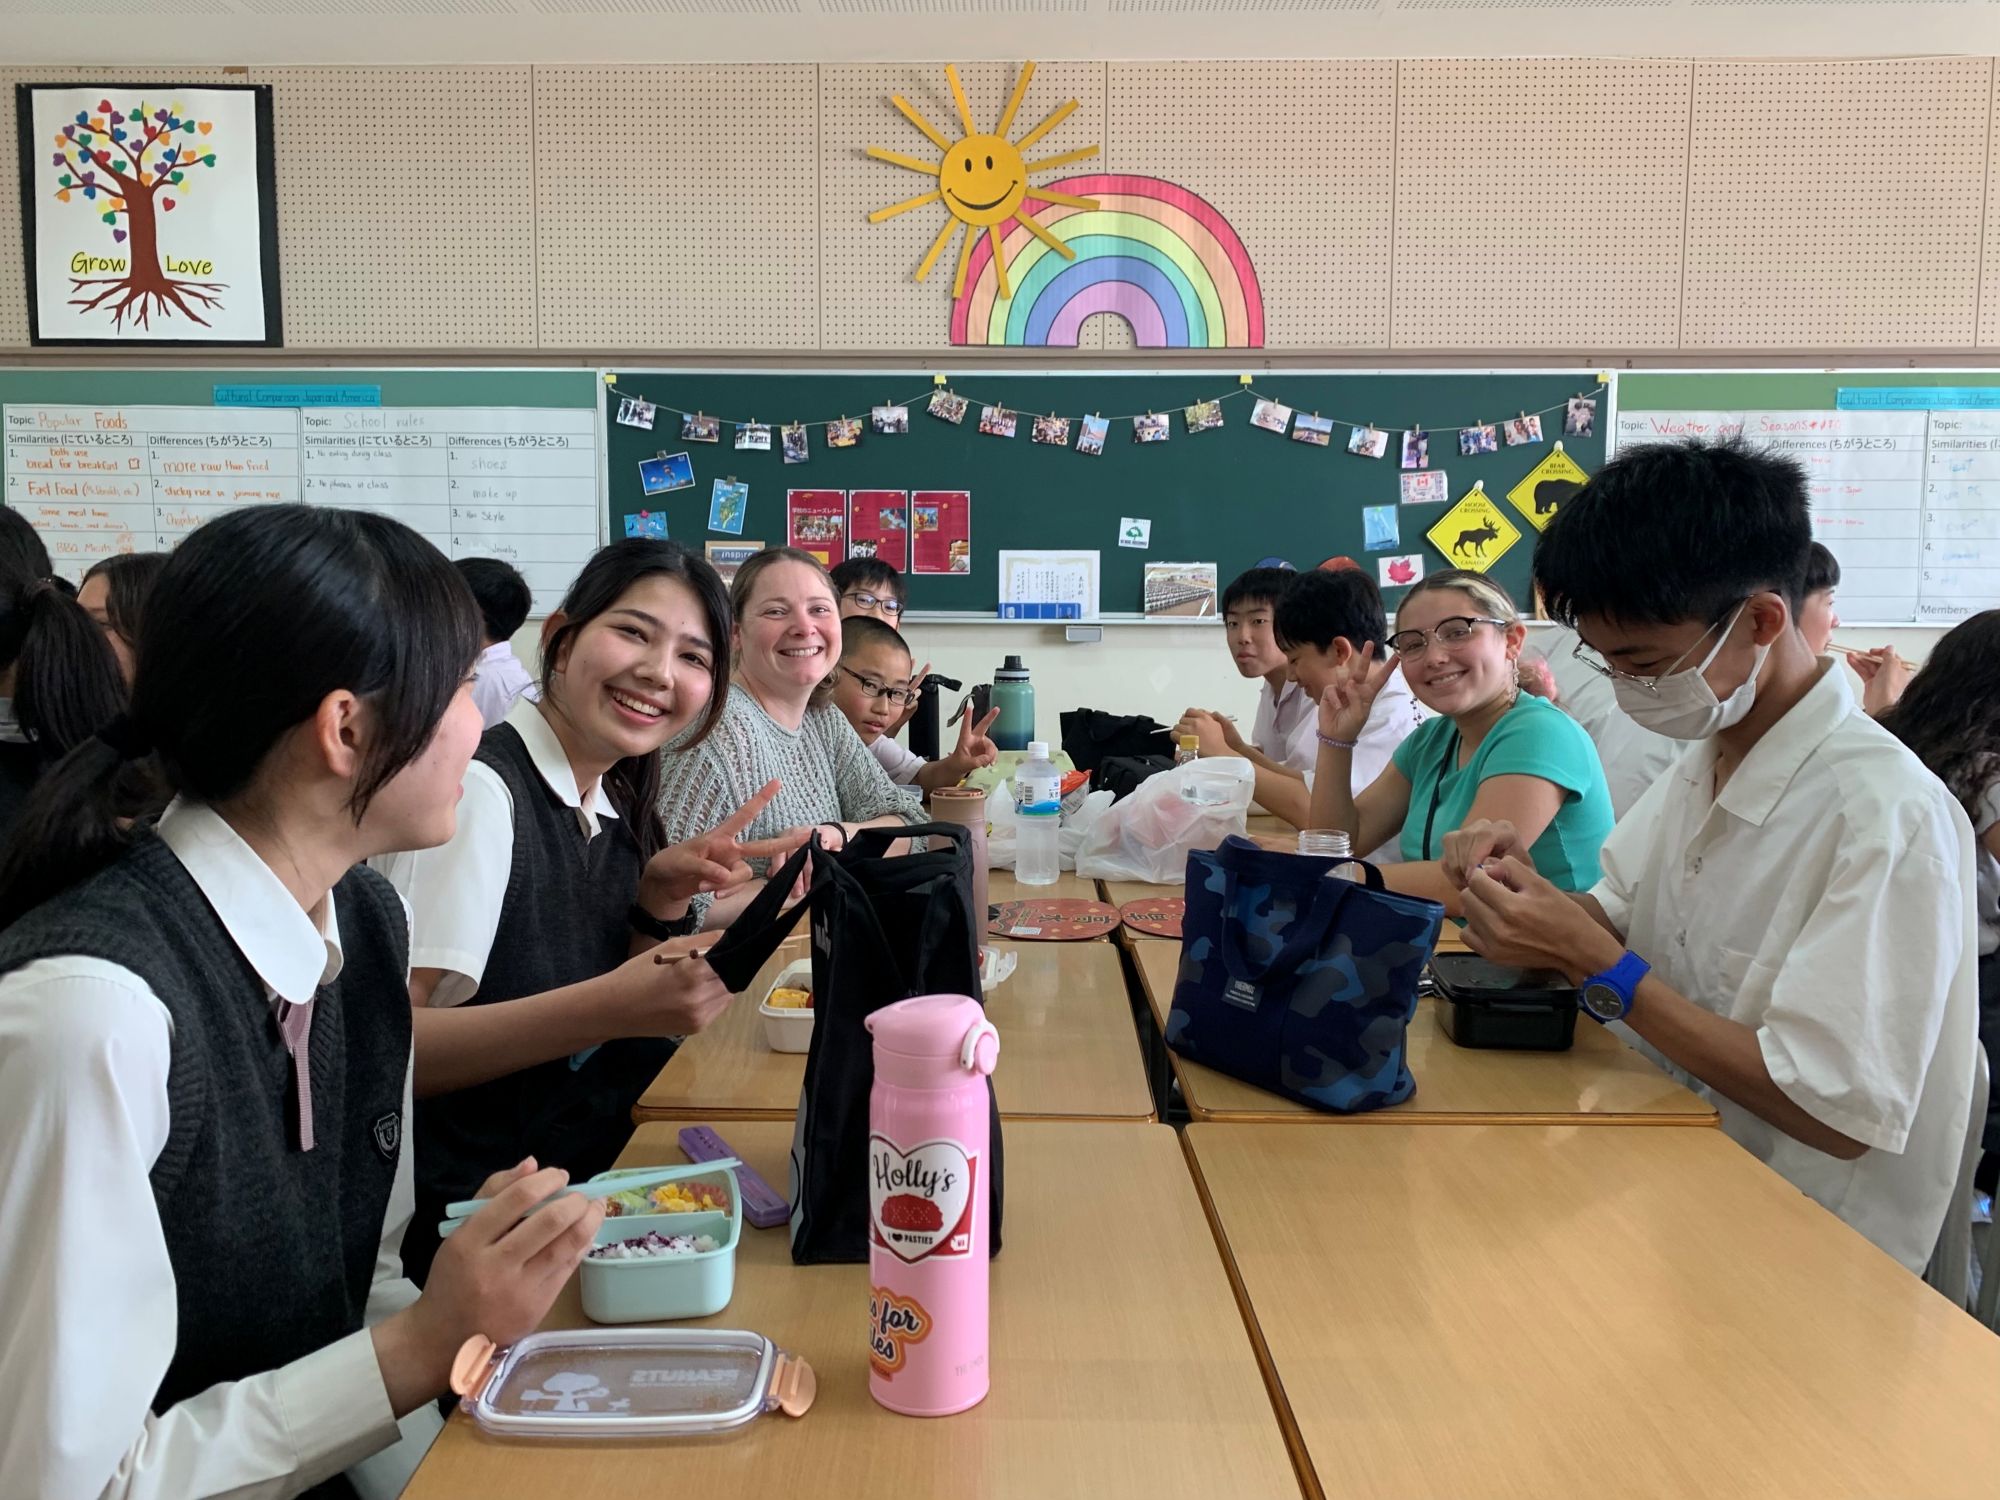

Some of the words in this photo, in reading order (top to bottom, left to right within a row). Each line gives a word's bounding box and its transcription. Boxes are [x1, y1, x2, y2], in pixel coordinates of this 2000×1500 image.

[71, 252, 126, 274] Grow
[166, 255, 213, 275] Love
[9, 415, 35, 427] Topic:
[38, 411, 83, 431] Popular
[94, 411, 128, 430] Foods
[304, 416, 332, 428] Topic:
[343, 412, 387, 430] School
[396, 415, 425, 428] rules
[1620, 420, 1648, 431] Topic:
[1933, 419, 1962, 430] Topic:
[8, 434, 59, 445] Similarities
[61, 434, 133, 446] (にているところ)
[149, 435, 203, 446] Differences
[206, 436, 272, 448] (ちがうところ)
[304, 435, 356, 446] Similarities
[358, 435, 432, 448] (にているところ)
[448, 436, 502, 447] Differences
[503, 436, 569, 448] (ちがうところ)
[1772, 439, 1827, 450] Differences
[1829, 440, 1896, 451] (ちがうところ)
[1931, 439, 1987, 450] Similarities
[9, 448, 18, 458] 1.
[305, 450, 314, 460] 1.
[26, 458, 53, 469] bread
[151, 450, 160, 460] 1.
[163, 461, 196, 474] more
[200, 462, 222, 472] raw
[246, 459, 269, 472] fried
[450, 451, 458, 460] 1.
[471, 456, 508, 470] shoes
[9, 477, 19, 487] 2.
[28, 480, 51, 496] Fast
[55, 481, 78, 496] Food
[154, 478, 163, 488] 2.
[306, 478, 315, 488] 2.
[451, 479, 460, 489] 2.
[473, 486, 499, 499] make
[505, 490, 518, 502] up
[156, 507, 165, 517] 3.
[452, 508, 461, 518] 3.
[481, 510, 505, 523] Style
[453, 537, 462, 546] 4.
[1920, 604, 1971, 615] Members:
[873, 1152, 957, 1198] Holly's
[904, 1234, 934, 1244] PASTIES
[880, 1300, 919, 1334] for
